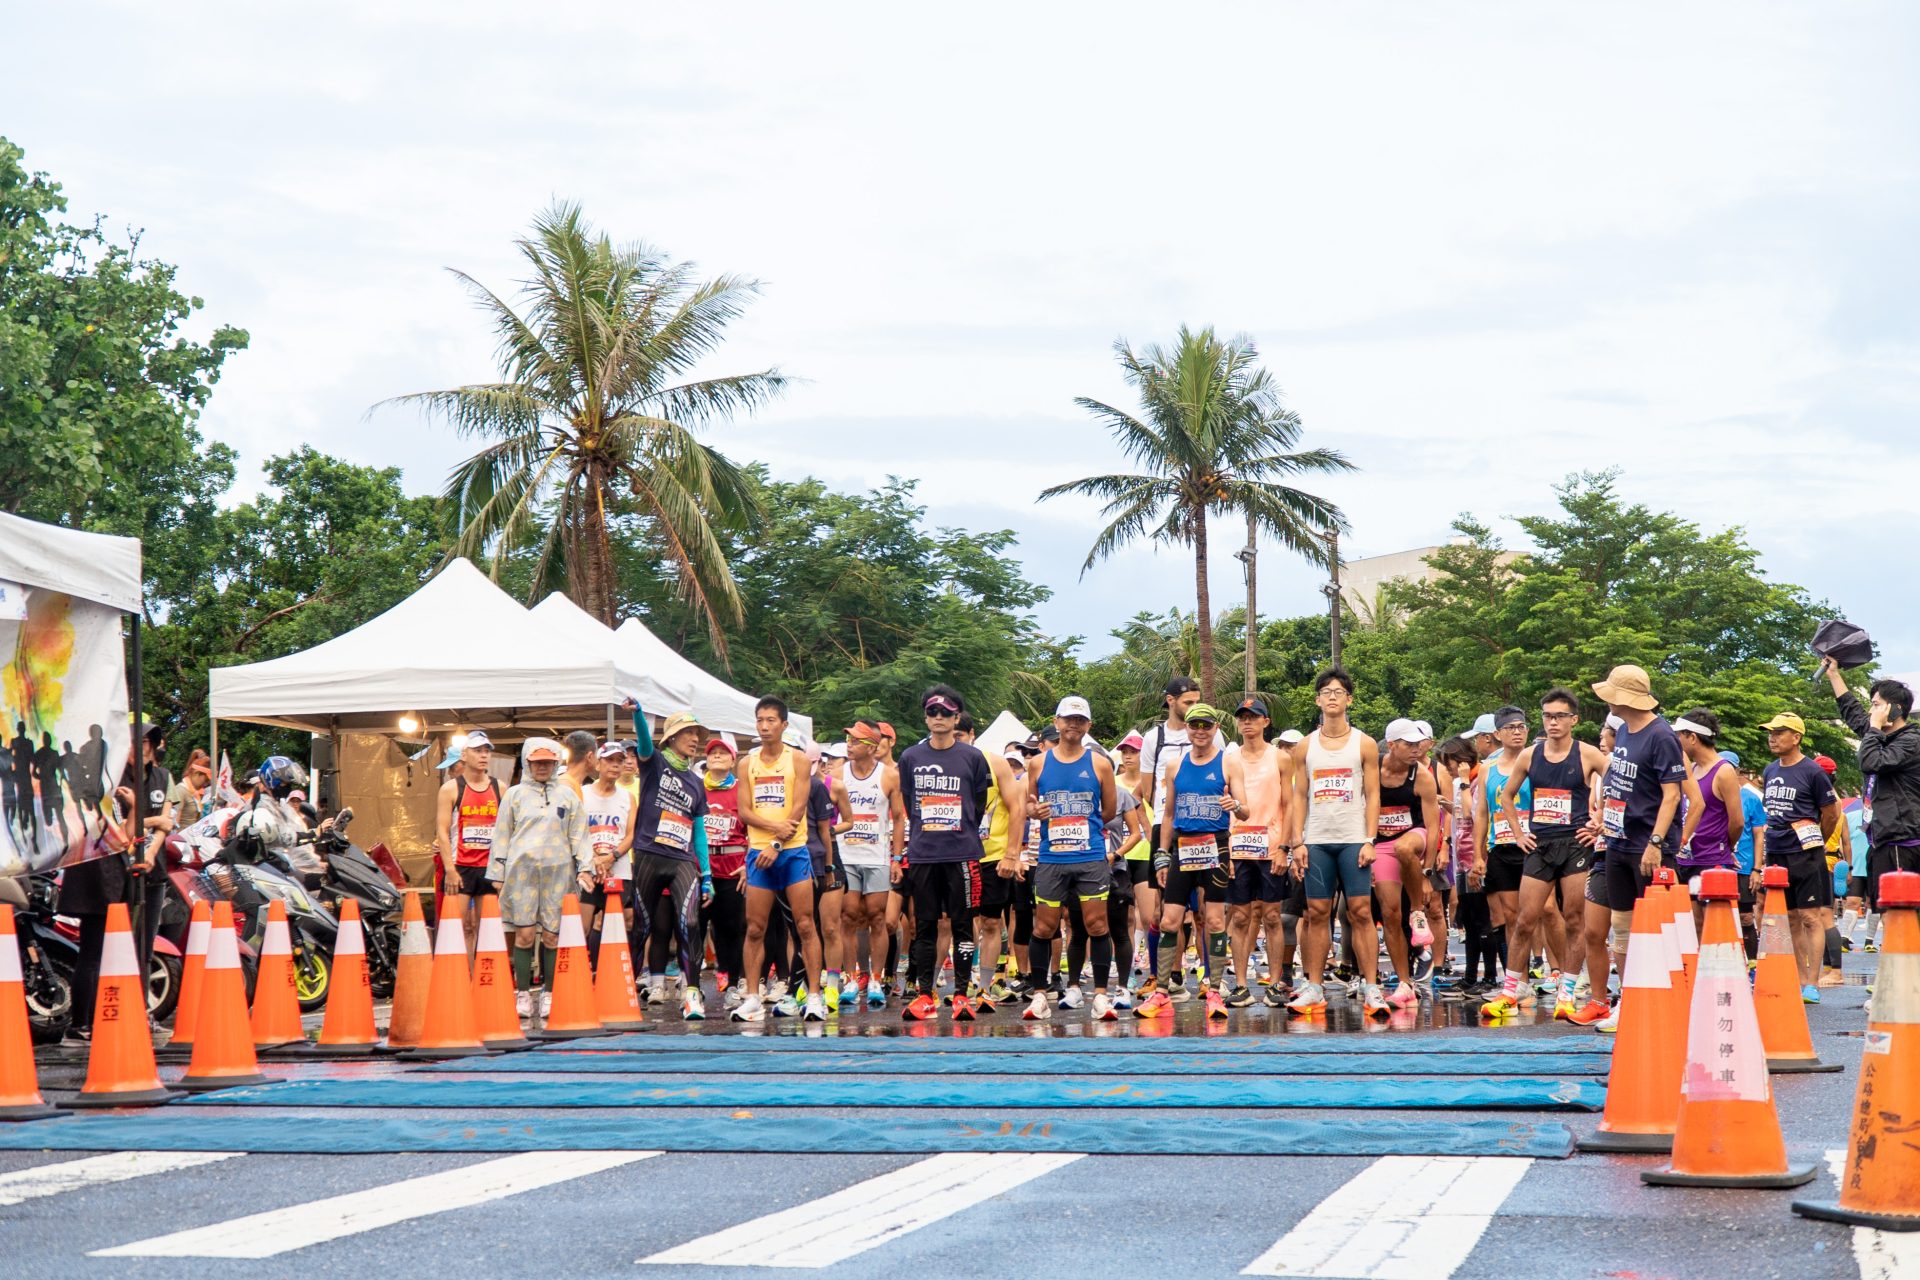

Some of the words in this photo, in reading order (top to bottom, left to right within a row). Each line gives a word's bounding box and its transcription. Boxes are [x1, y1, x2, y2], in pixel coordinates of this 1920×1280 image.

[914, 774, 960, 791] 跑向成功
[1325, 779, 1346, 788] 2187
[763, 785, 785, 794] 3118
[848, 790, 877, 807] Taipei
[1543, 799, 1563, 809] 2041
[933, 807, 955, 816] 3009
[703, 816, 724, 827] 2070
[1385, 815, 1405, 824] 2043
[853, 823, 873, 831] 3001
[1504, 821, 1524, 830] 24
[1059, 827, 1083, 837] 3040
[1241, 835, 1263, 844] 3060
[1189, 846, 1212, 856] 3042
[1717, 992, 1736, 1084] 請勿停車
